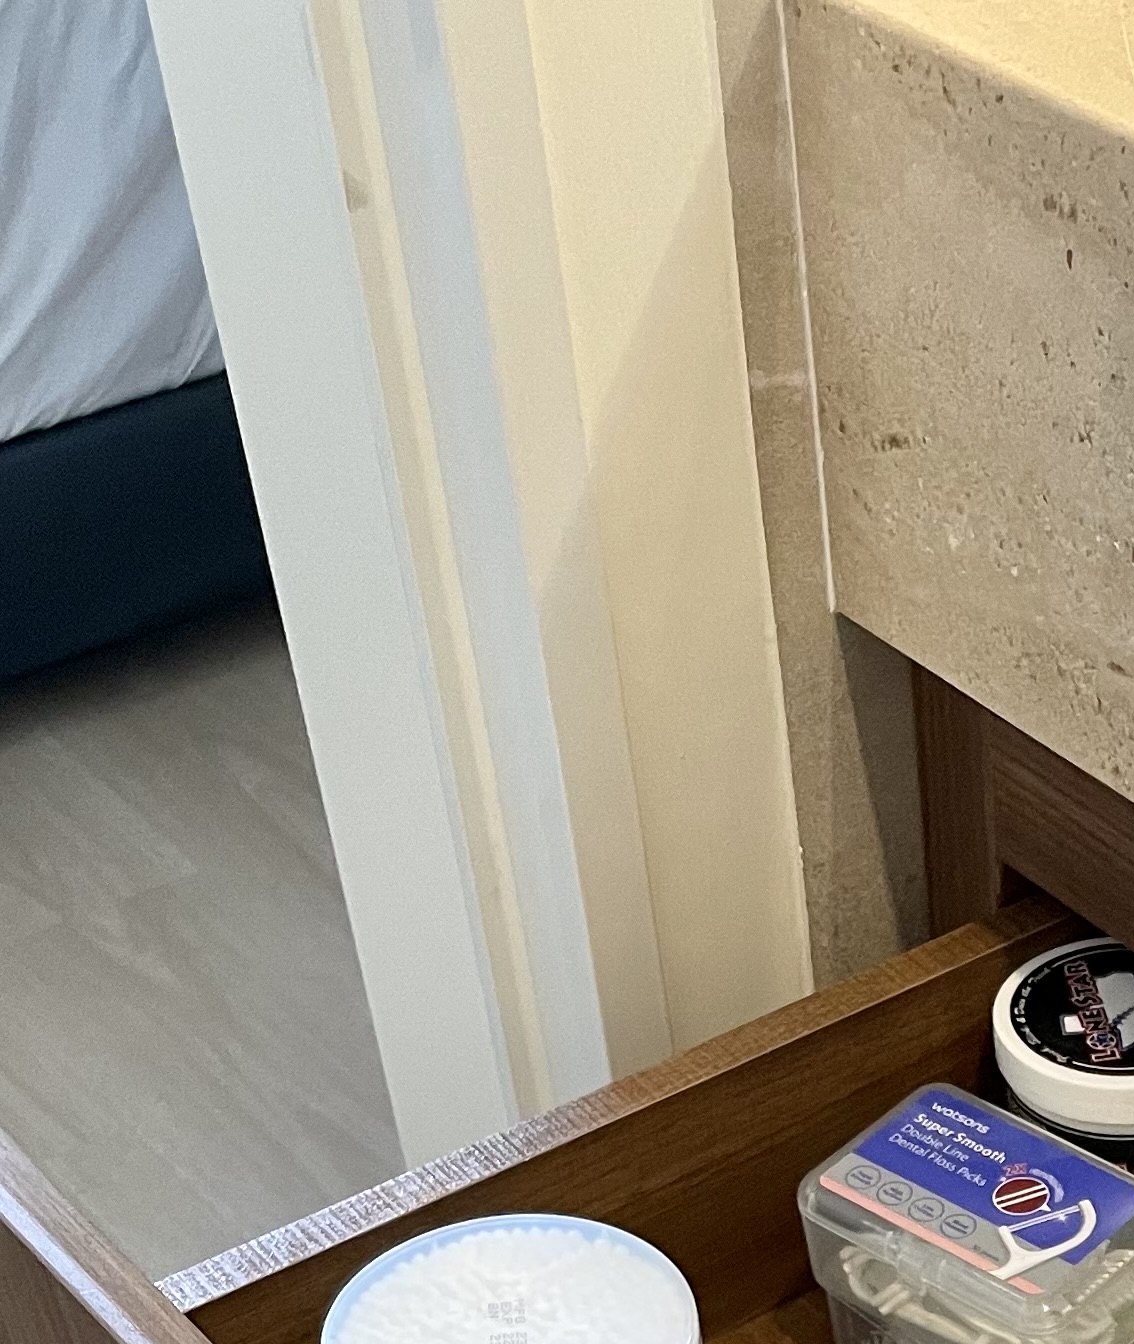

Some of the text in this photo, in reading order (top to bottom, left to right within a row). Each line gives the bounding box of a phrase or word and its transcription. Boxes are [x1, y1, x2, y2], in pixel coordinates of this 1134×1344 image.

[913, 1113, 1007, 1164] Super Smooth
[931, 1102, 990, 1134] watsons
[888, 1133, 987, 1187] Dental Floss Picks
[901, 1123, 970, 1163] Double Line
